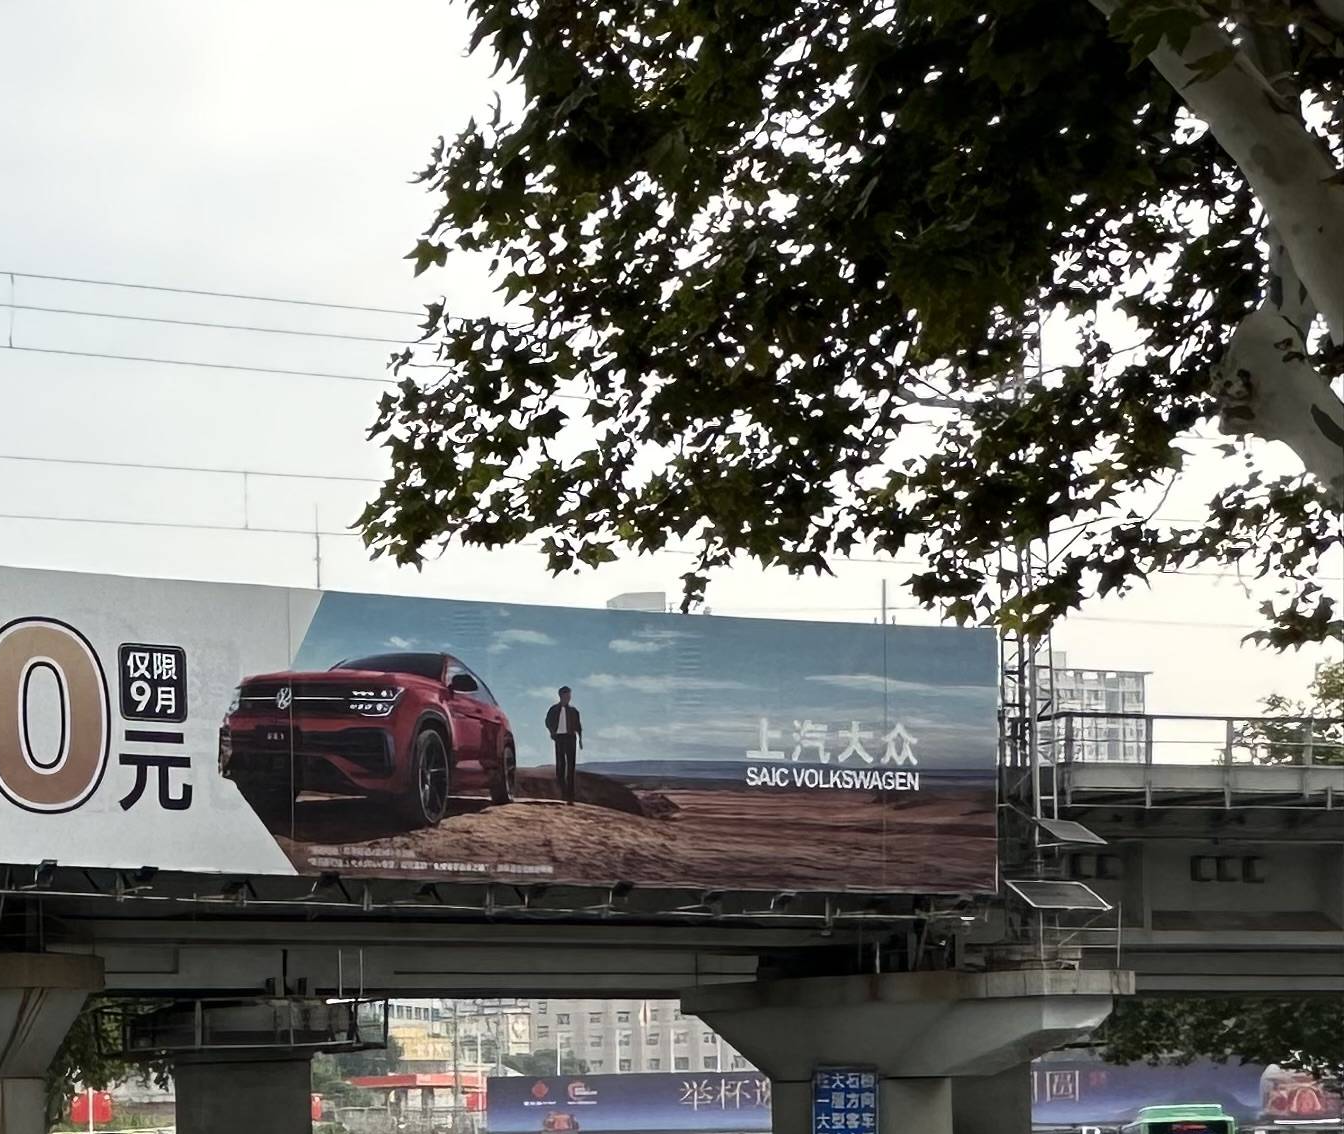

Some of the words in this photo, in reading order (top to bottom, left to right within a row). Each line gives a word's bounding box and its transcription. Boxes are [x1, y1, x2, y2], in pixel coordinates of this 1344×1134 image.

[127, 651, 178, 680] 仅限
[130, 680, 176, 715] 9月
[746, 717, 918, 766] 上汽大众
[118, 730, 193, 811] 元
[746, 766, 789, 788] SAIC
[793, 768, 921, 792] VOLKSWAGEN
[816, 1112, 875, 1130] 大型客车
